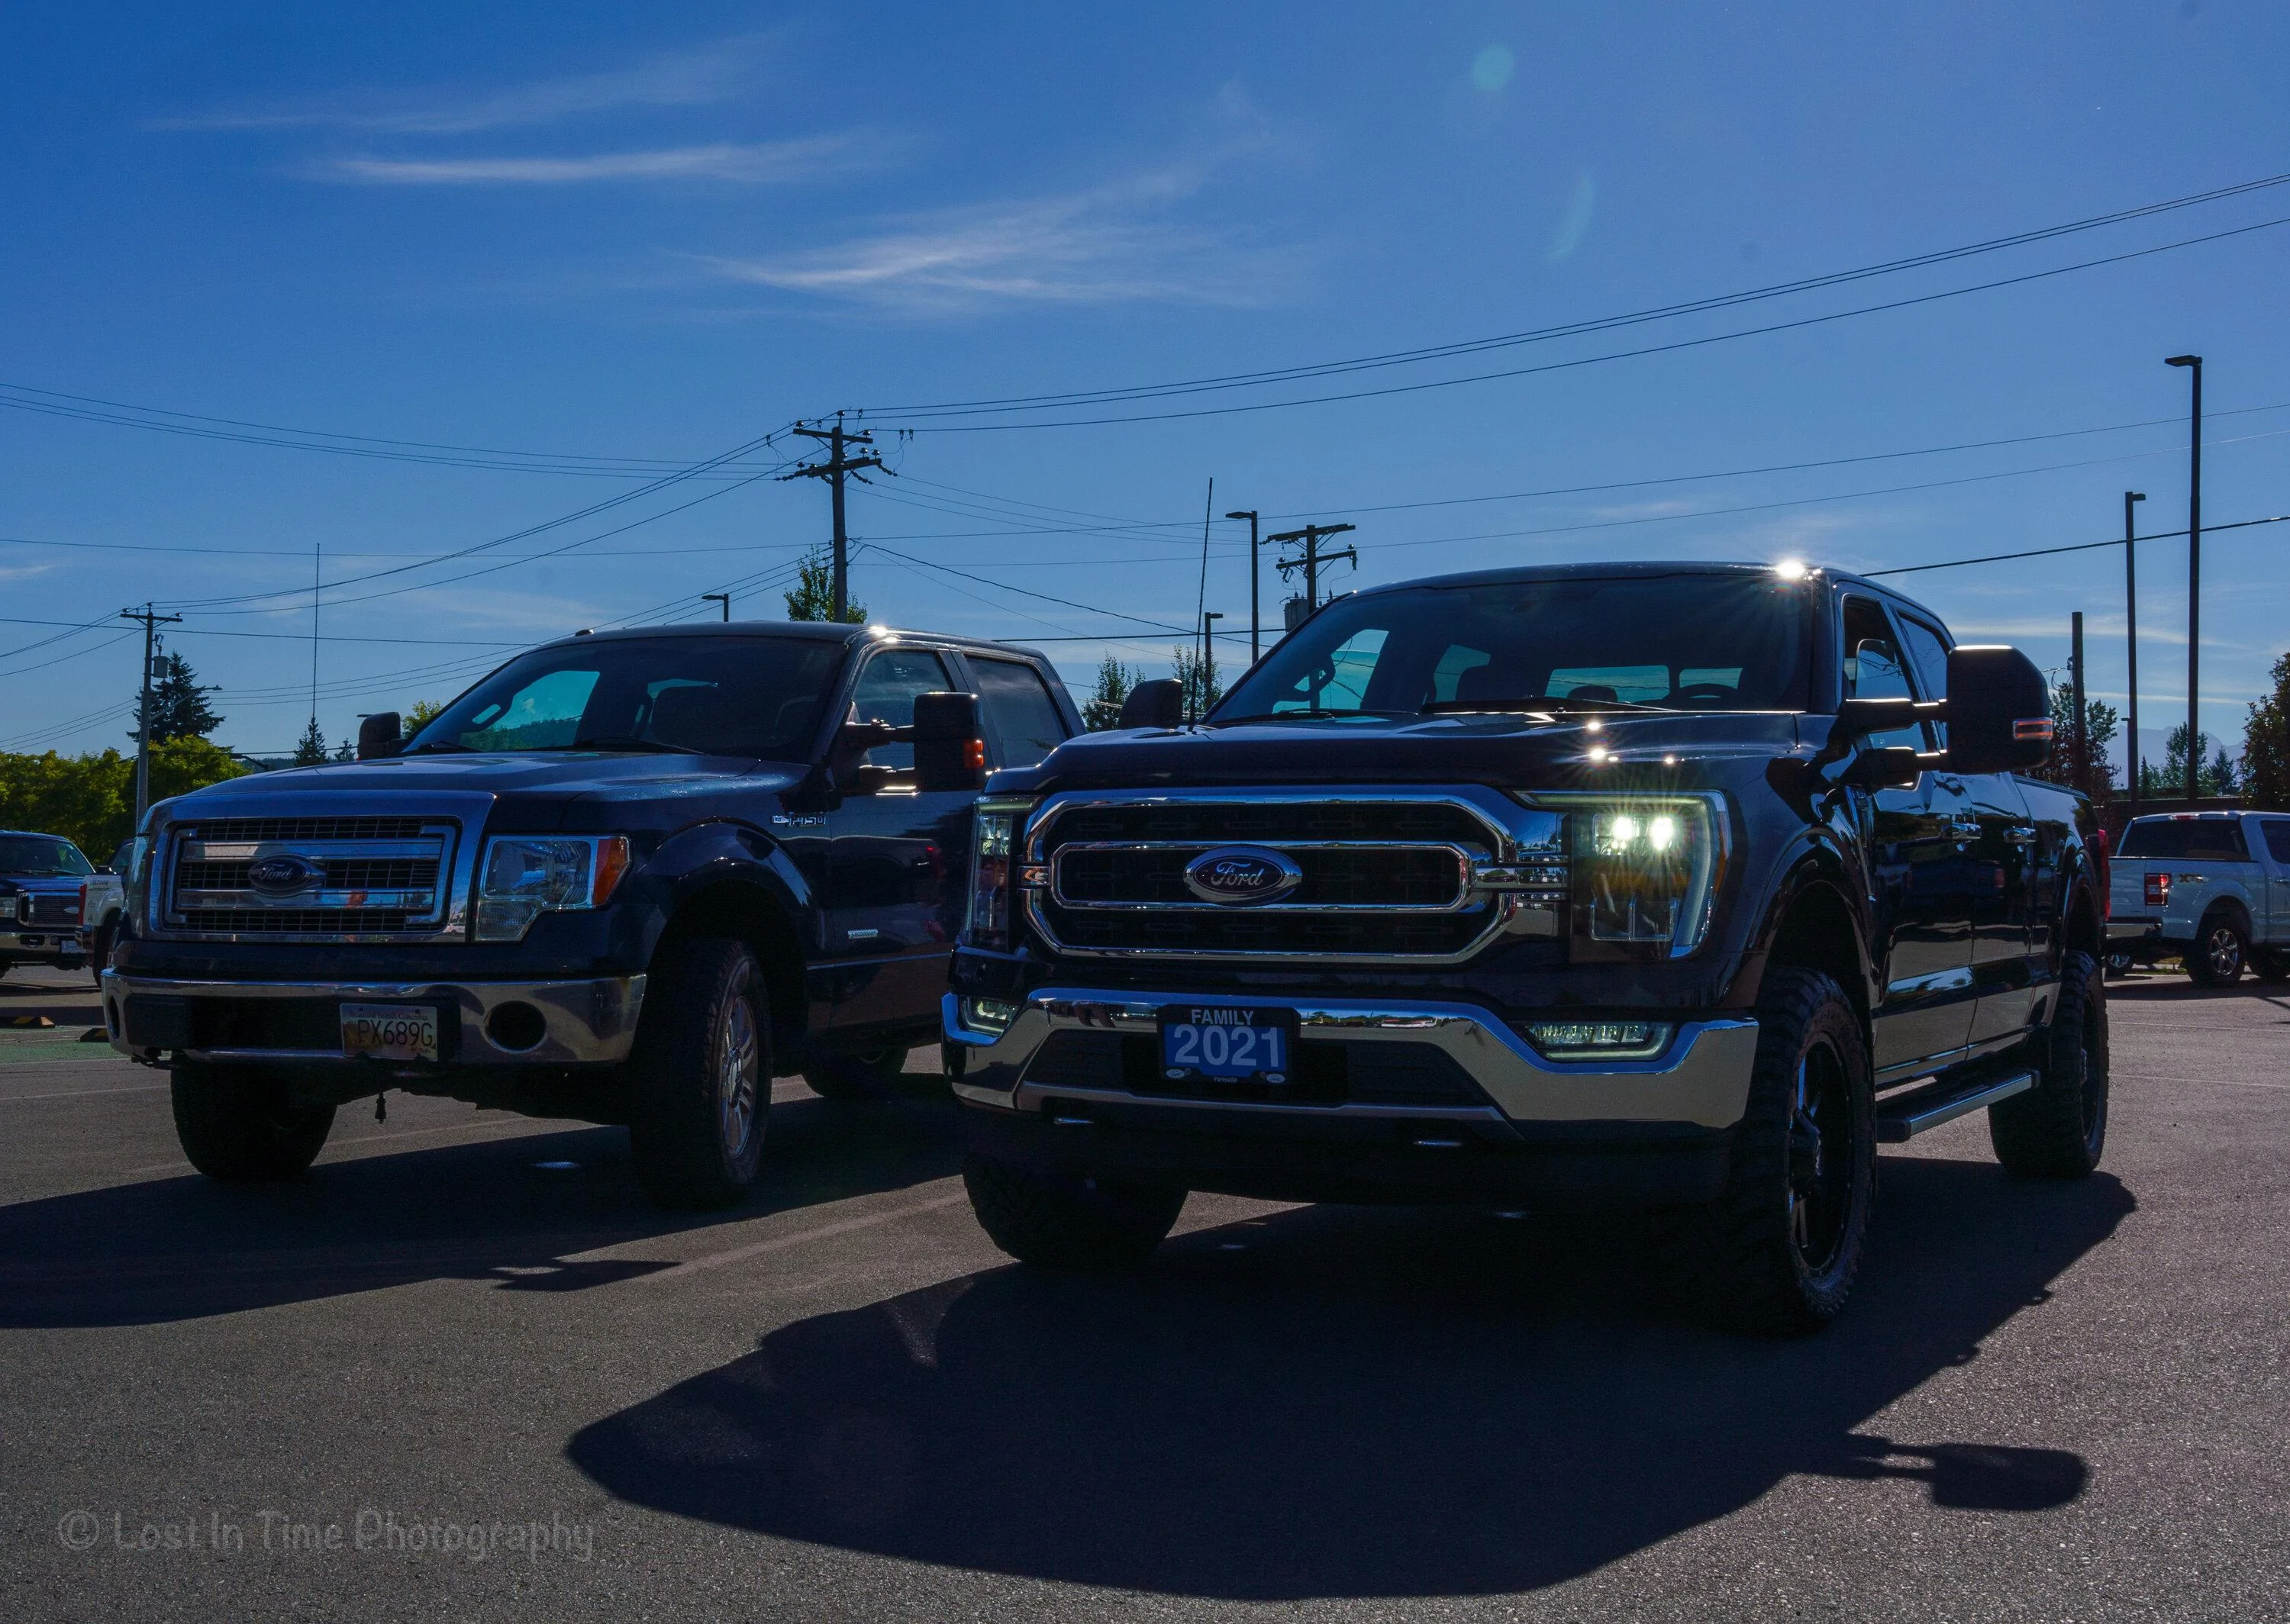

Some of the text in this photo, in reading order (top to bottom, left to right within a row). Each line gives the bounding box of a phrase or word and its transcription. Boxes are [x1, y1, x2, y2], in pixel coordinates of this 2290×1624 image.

[260, 862, 294, 881] Ford
[1211, 862, 1265, 886] Ford
[1191, 1009, 1254, 1026] FAMILY
[357, 1019, 433, 1046] PX689G
[1173, 1023, 1279, 1068] 2021
